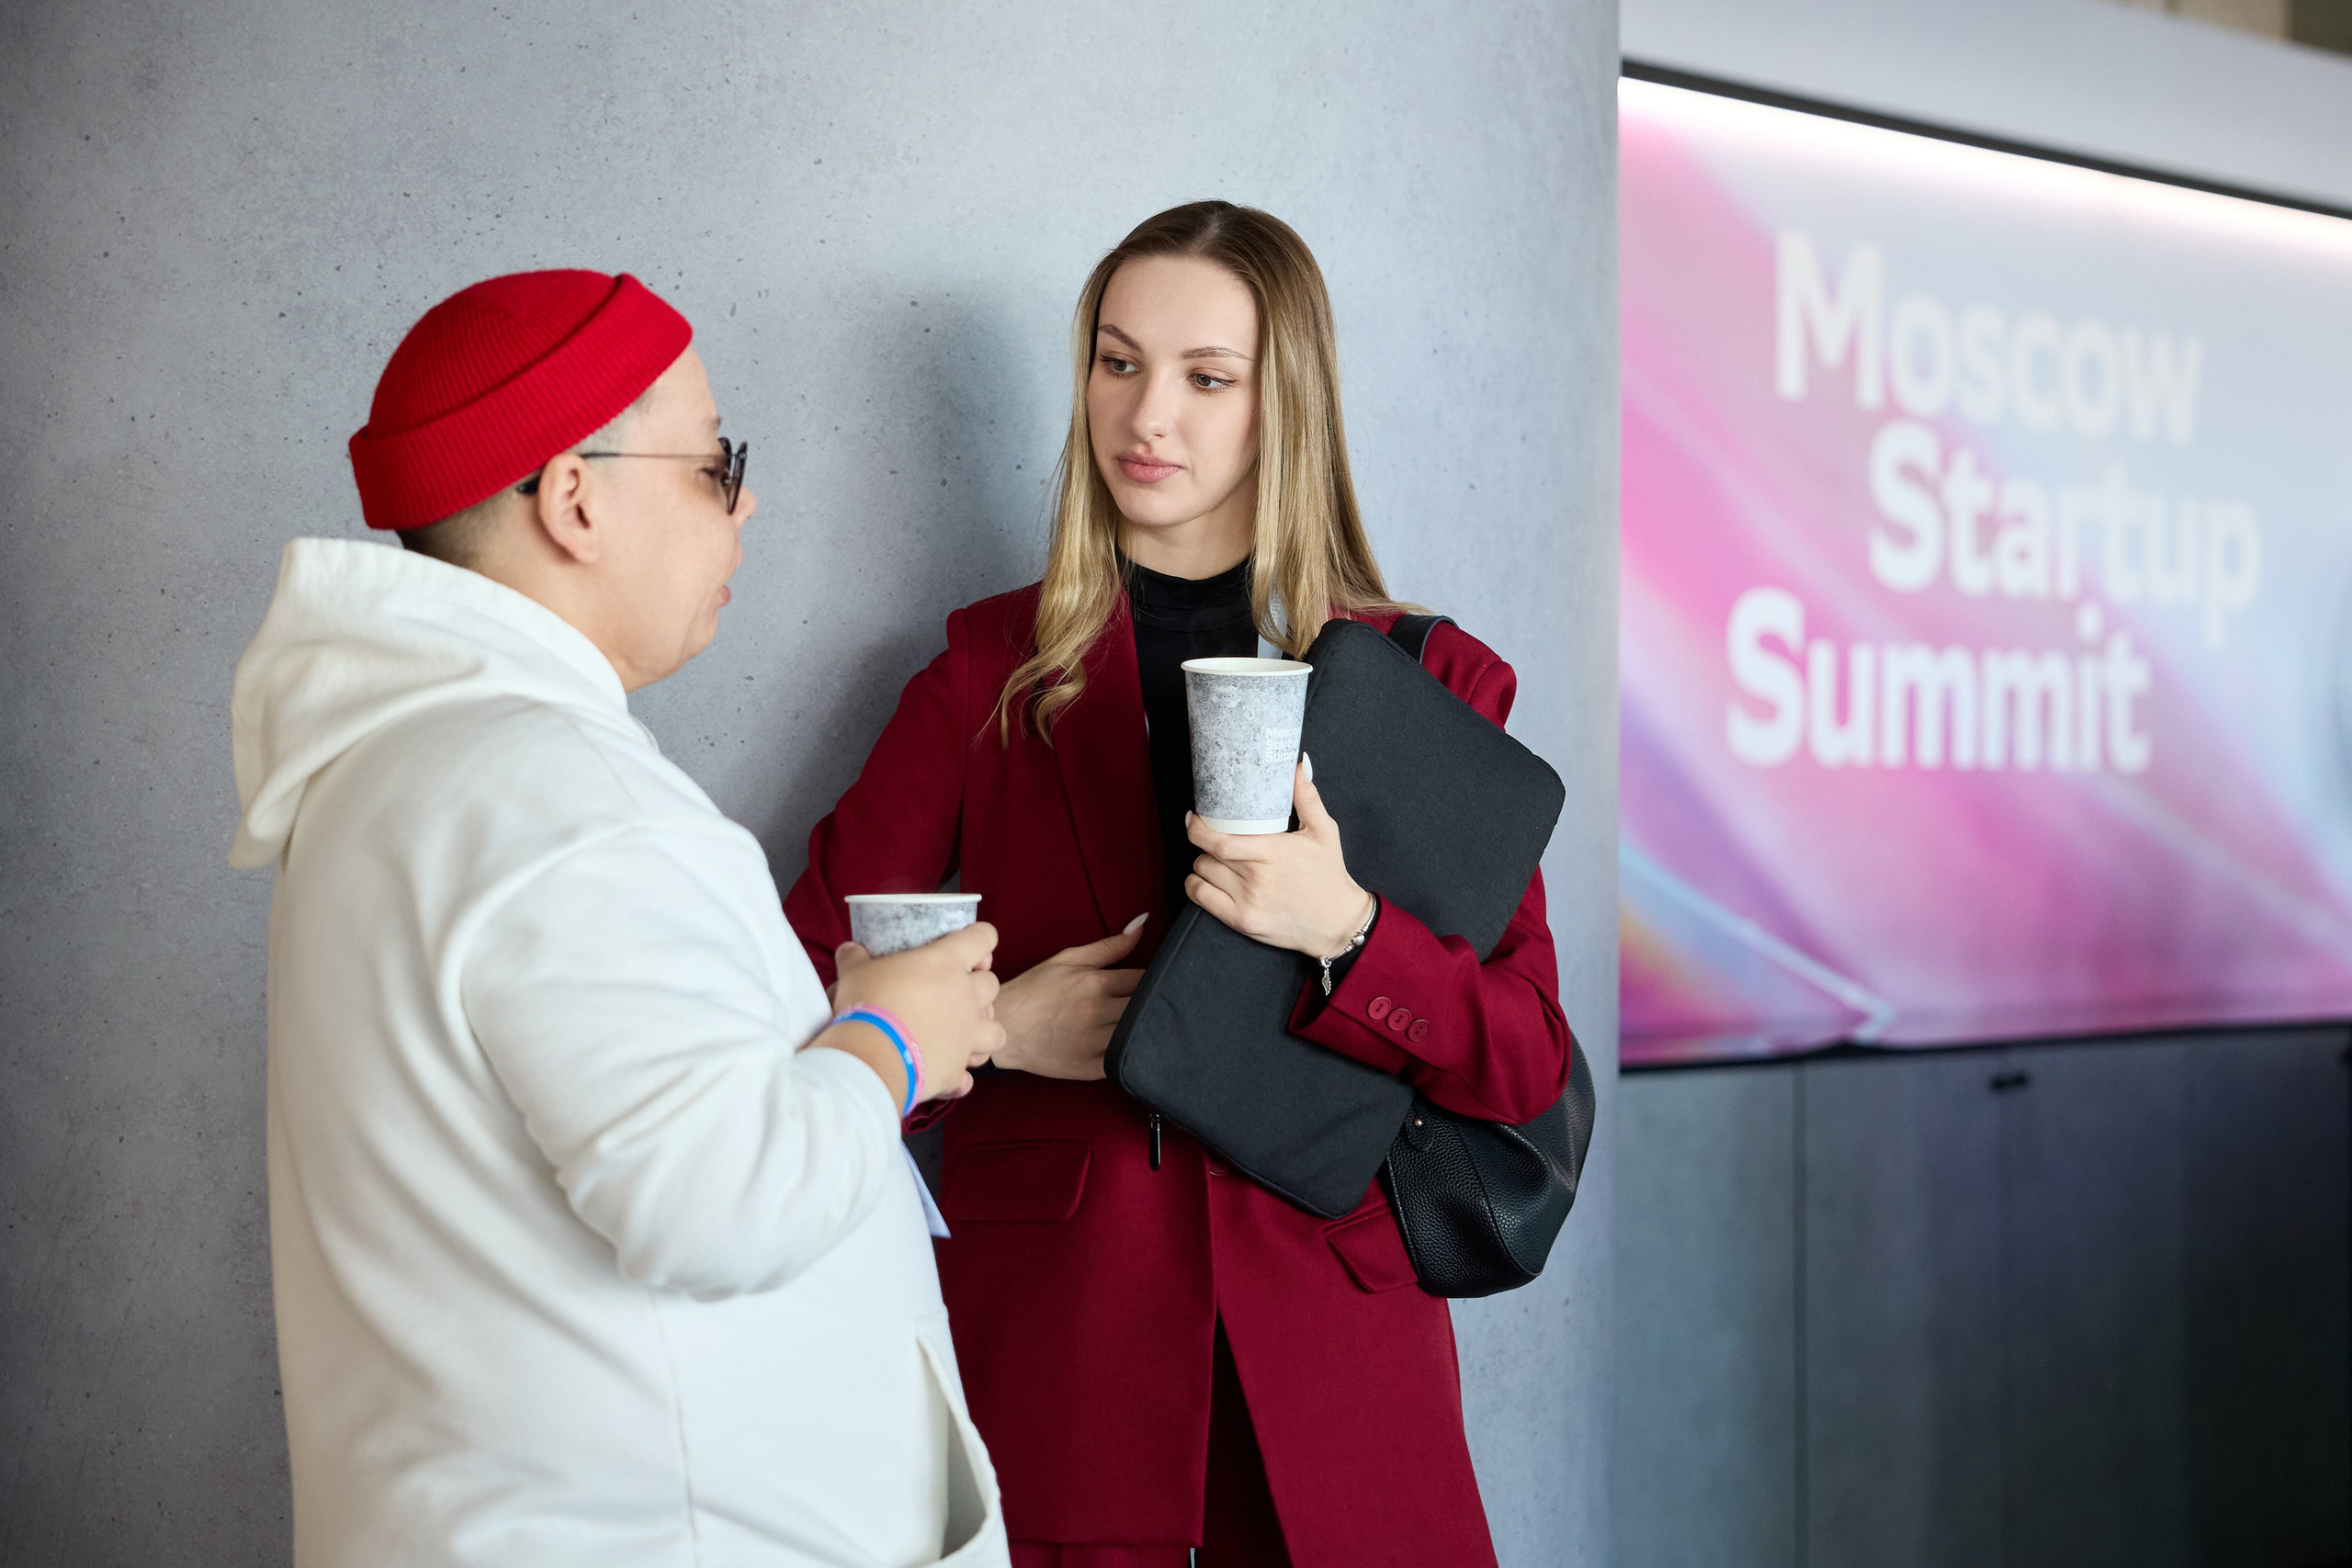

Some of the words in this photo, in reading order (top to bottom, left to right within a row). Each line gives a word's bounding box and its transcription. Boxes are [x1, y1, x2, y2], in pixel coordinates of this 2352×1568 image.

[1776, 231, 2204, 445] Moscow
[1869, 420, 2262, 650] Startup
[1724, 587, 2151, 773] Summit
